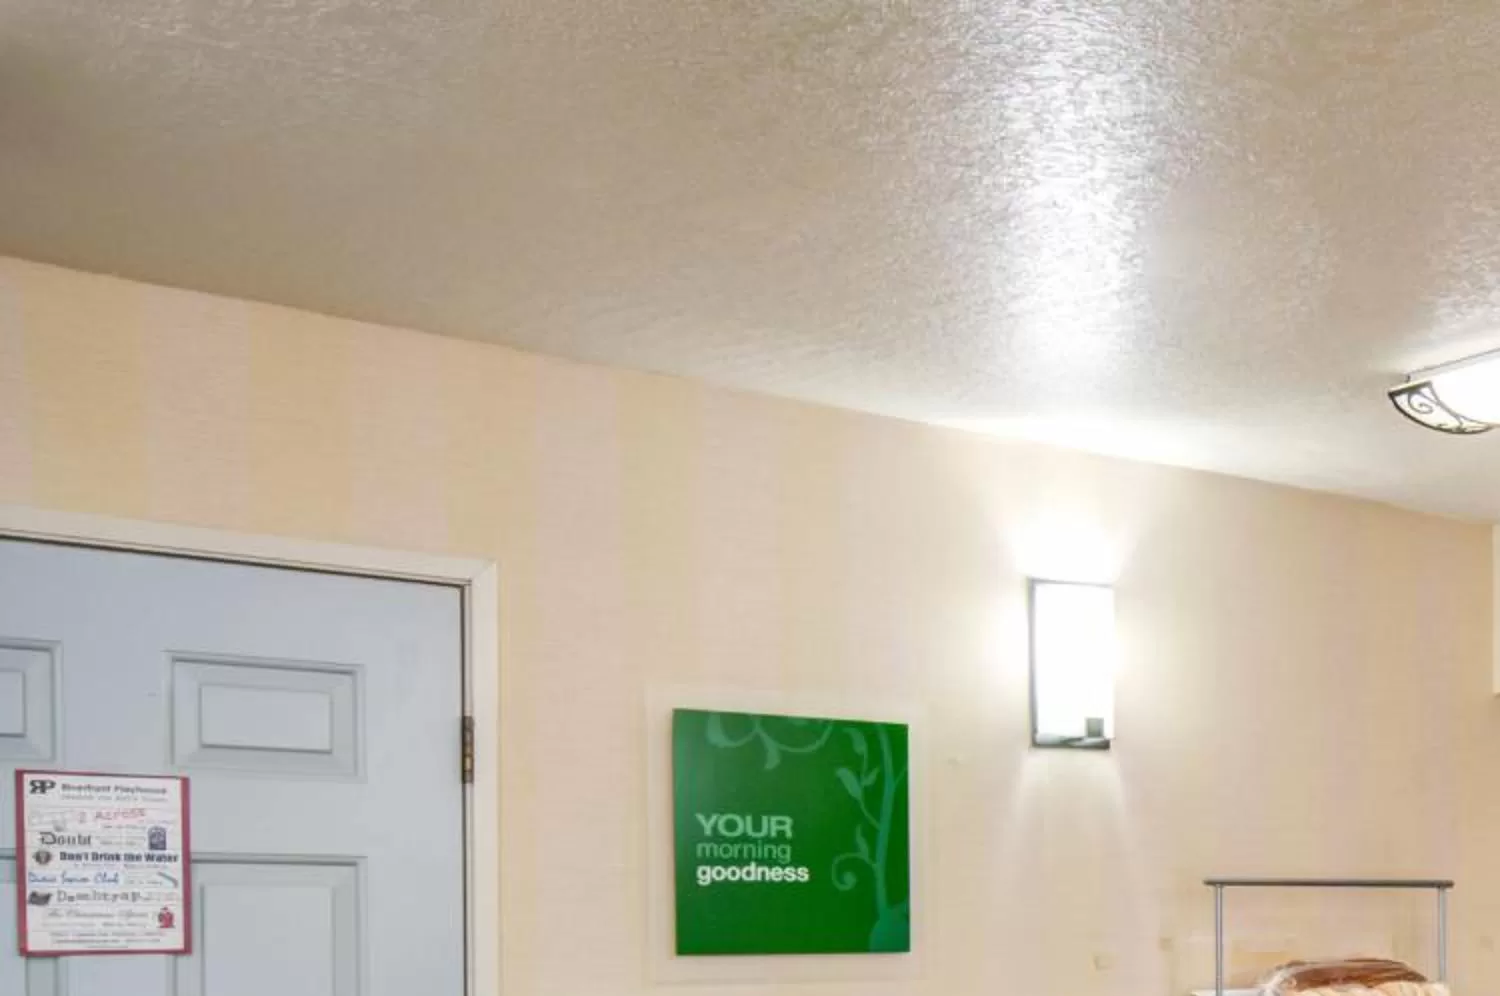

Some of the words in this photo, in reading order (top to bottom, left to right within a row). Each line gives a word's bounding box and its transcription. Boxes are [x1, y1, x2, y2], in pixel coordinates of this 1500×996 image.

[695, 813, 794, 838] YOUR
[697, 840, 792, 864] morning
[696, 862, 810, 886] goodness
